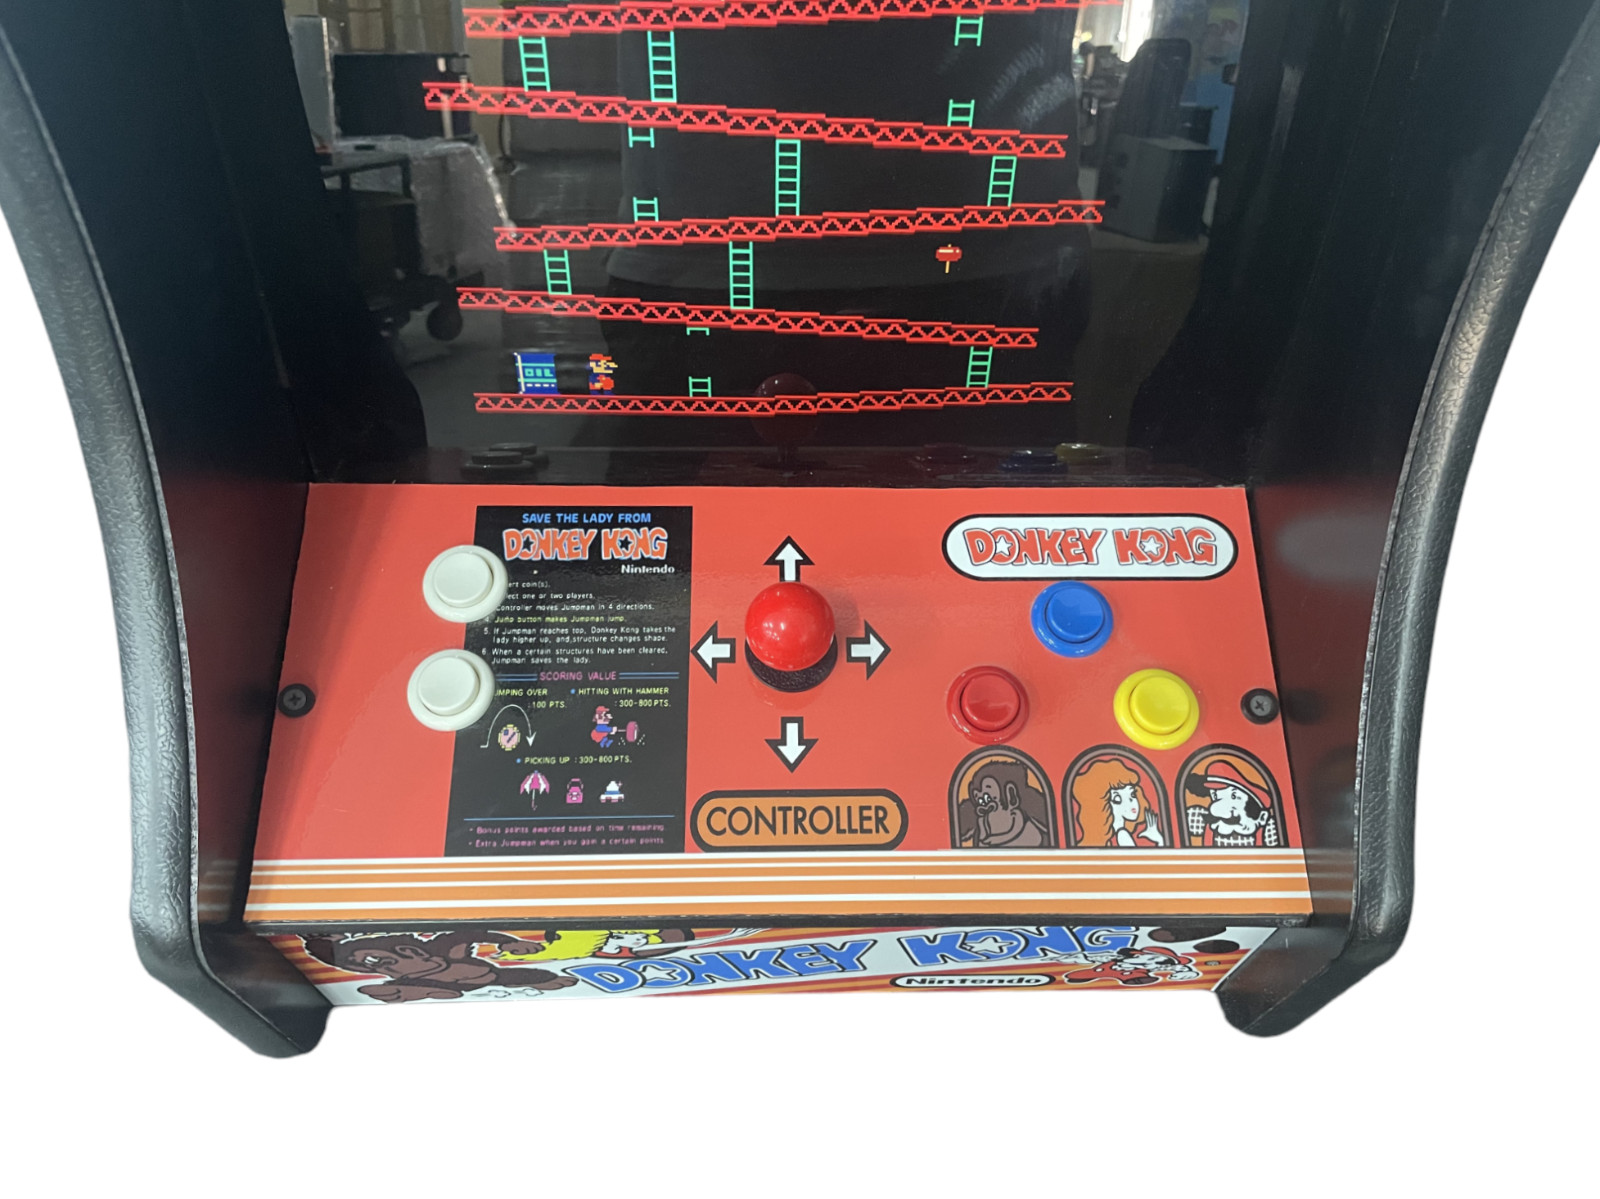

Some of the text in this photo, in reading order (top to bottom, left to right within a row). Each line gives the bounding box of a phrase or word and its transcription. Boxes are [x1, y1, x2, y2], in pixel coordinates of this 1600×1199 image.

[524, 368, 553, 377] OIL
[522, 512, 651, 524] SAVE THE LADY FROM
[502, 527, 668, 561] DONKEY KONG
[962, 526, 1217, 566] DONKEY KONG
[621, 564, 675, 574] Nintendo
[501, 627, 537, 635] Jumpman
[539, 627, 569, 635] reaches
[590, 626, 618, 635] Donkey
[620, 626, 640, 634] Kong
[664, 625, 676, 633] the
[492, 635, 510, 644] lady
[512, 635, 537, 644] higher
[610, 634, 641, 643] changes
[491, 647, 513, 656] When
[524, 648, 552, 656] certain
[555, 647, 594, 655] structures
[597, 646, 615, 654] have
[491, 656, 527, 665] Jumpman
[530, 657, 553, 665] saves
[556, 656, 569, 664] the
[540, 671, 617, 681] SCORING VALUE
[495, 688, 548, 697] UMPING OVER
[578, 686, 670, 695] HITTING WITH HAMMER
[524, 756, 557, 765] PICKING
[558, 756, 570, 764] UP
[706, 805, 890, 836] CONTROLLER
[500, 839, 537, 847] Jumpman
[561, 925, 1140, 993] DONKEY KONG
